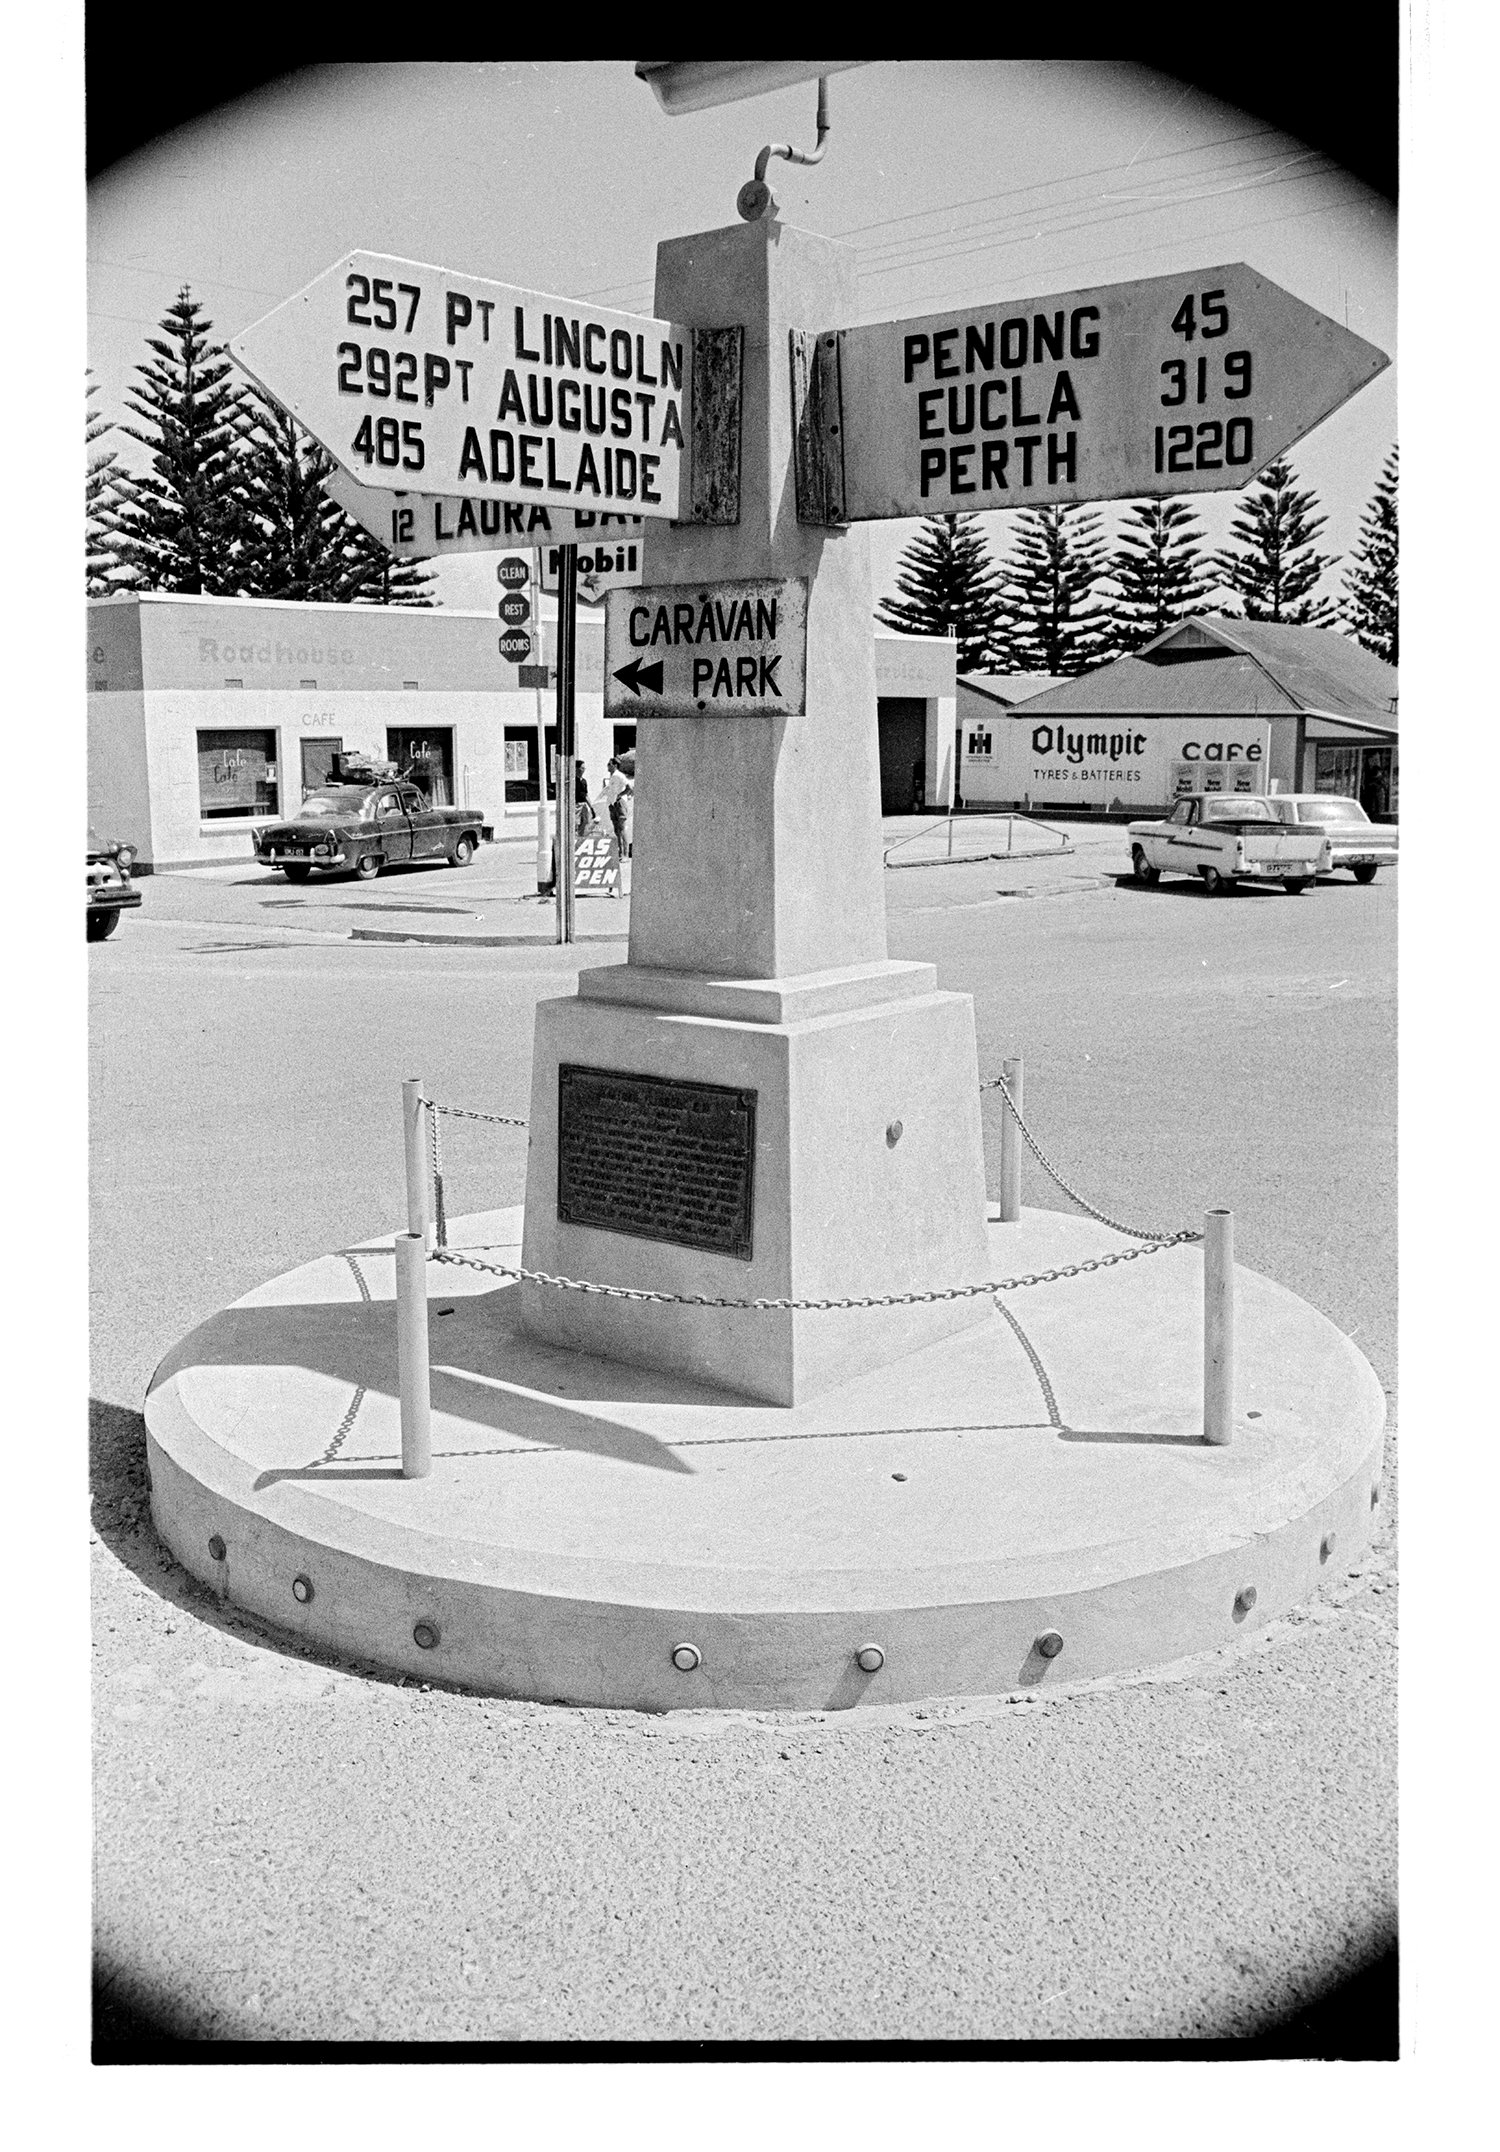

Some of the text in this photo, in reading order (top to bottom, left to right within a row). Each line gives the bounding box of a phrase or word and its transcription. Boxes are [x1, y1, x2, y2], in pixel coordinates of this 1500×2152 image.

[346, 274, 421, 333] 257
[515, 306, 684, 391] LINCOLN
[904, 288, 1230, 384] PENONG 45
[497, 369, 685, 449] AUGUSTA
[918, 349, 1252, 440] EUCLA 319
[352, 414, 662, 503] 485 ADELAIDE
[920, 416, 1253, 497] PERTH 1220
[392, 508, 414, 544] 12
[435, 499, 552, 540] LAURA
[500, 566, 526, 580] CLEAN
[504, 603, 524, 616] REST
[629, 598, 777, 647] CARAVAN
[198, 636, 356, 666] Roadhouse
[500, 638, 530, 651] ROOMS
[693, 654, 783, 698] PARK
[1032, 724, 1147, 763] Olympic
[1033, 769, 1141, 781] TYRES & BATTERIES
[574, 838, 612, 855] AS
[574, 855, 612, 869] OW
[574, 869, 618, 885] PEN
